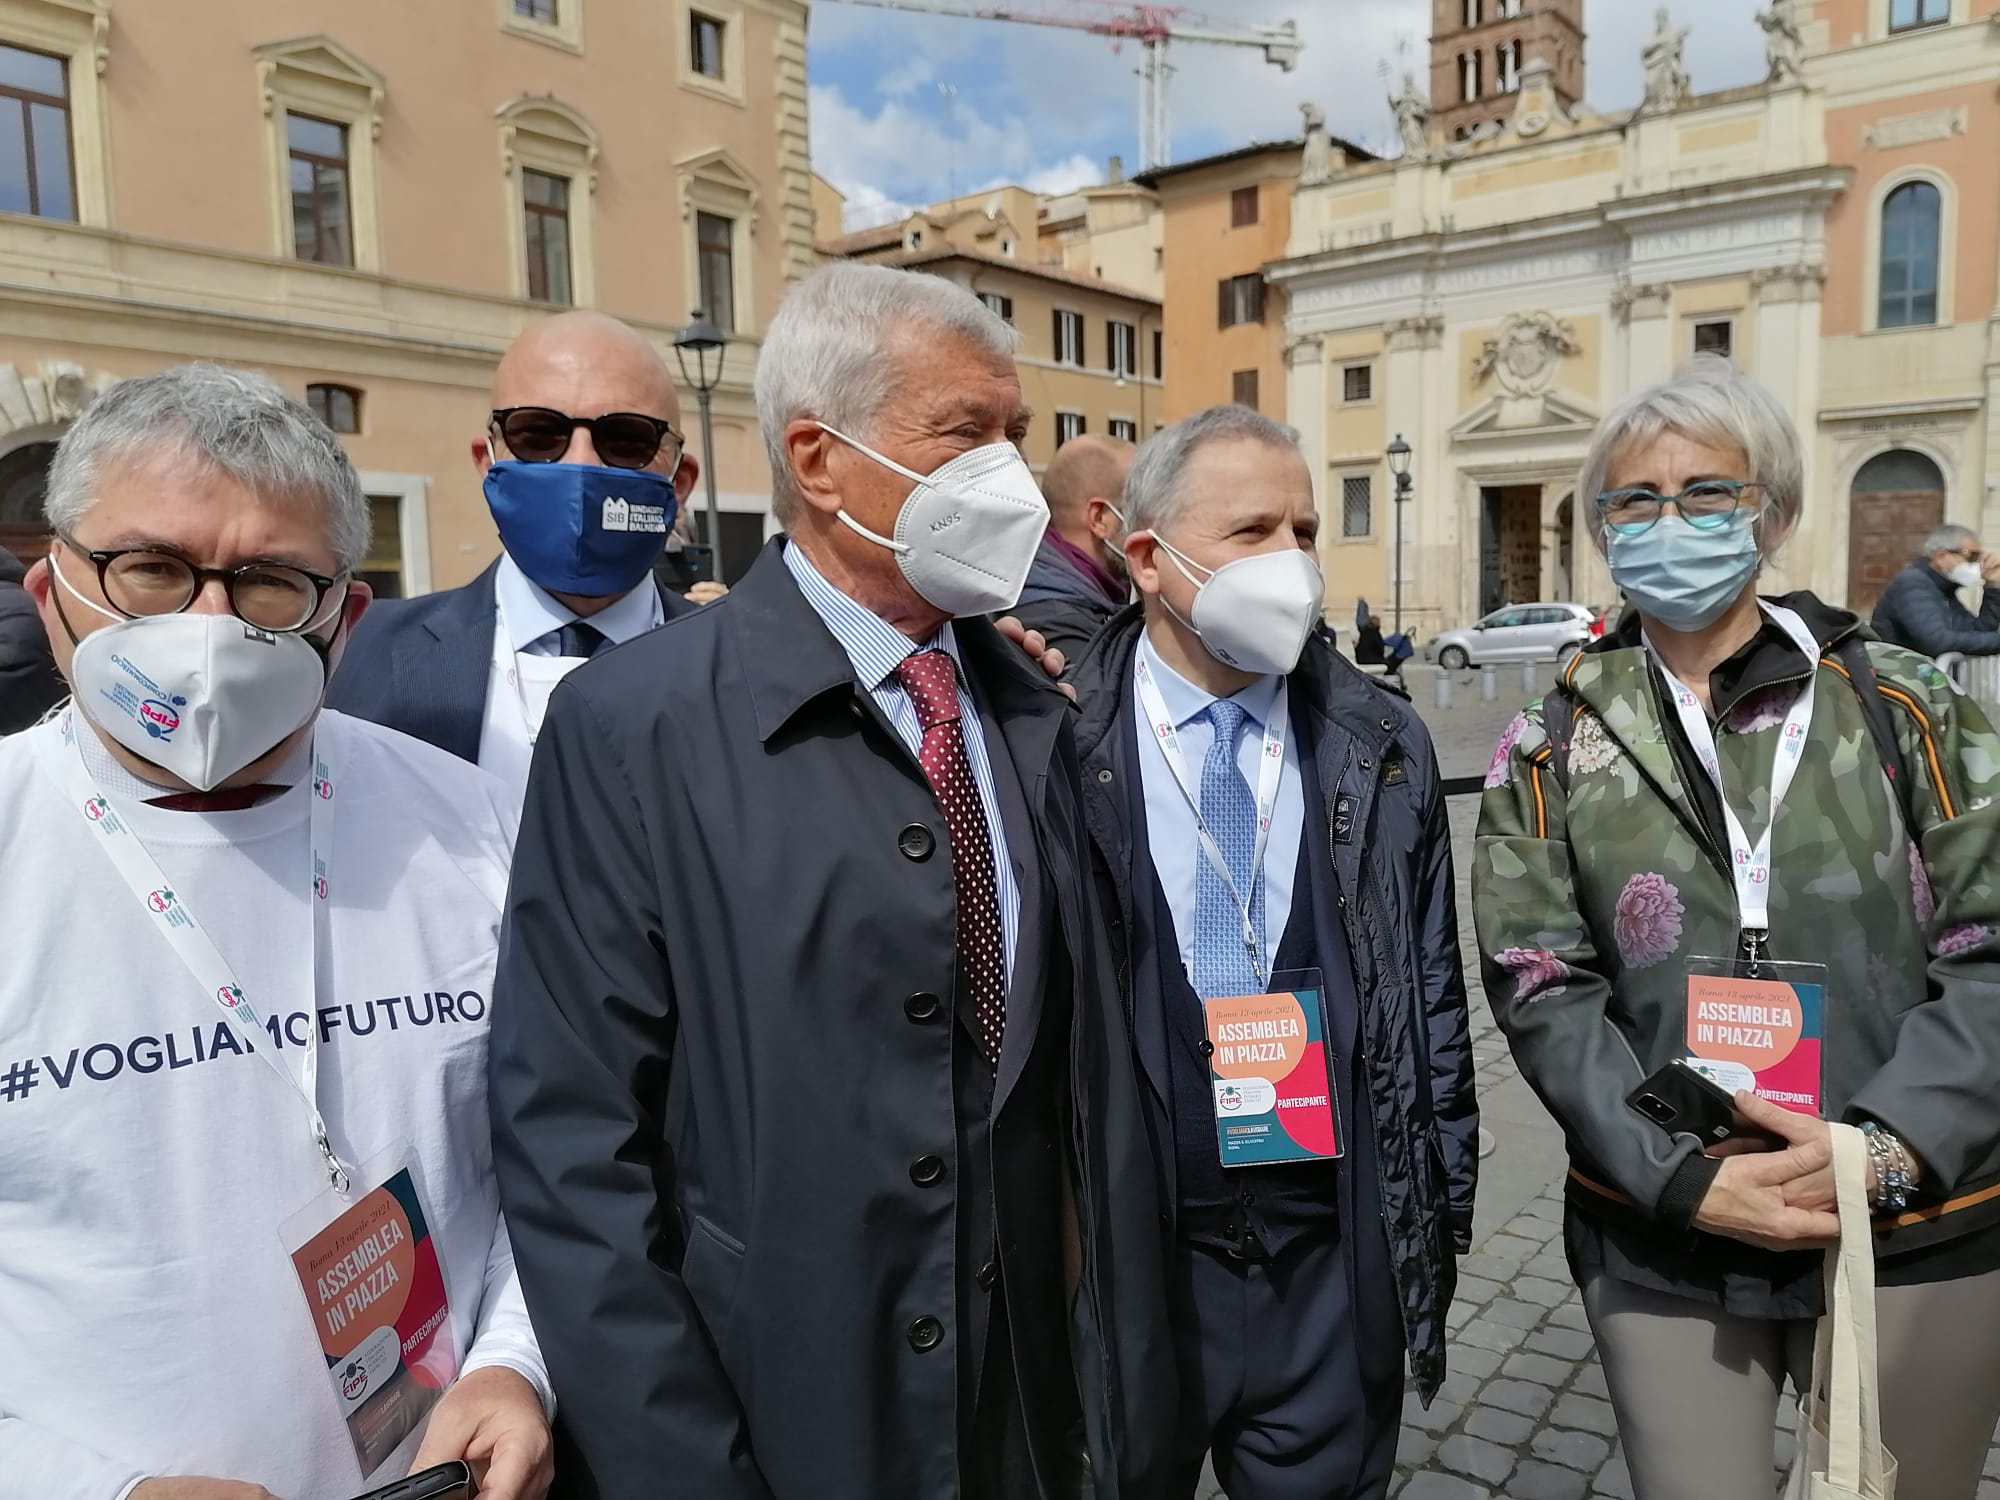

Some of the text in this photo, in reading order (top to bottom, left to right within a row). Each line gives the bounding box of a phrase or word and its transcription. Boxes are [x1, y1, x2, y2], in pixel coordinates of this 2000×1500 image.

[607, 512, 625, 523] SIB
[929, 511, 961, 532] KN95
[140, 701, 180, 729] FIPE
[150, 891, 169, 912] FIPE
[219, 986, 238, 1008] FIPE
[1727, 990, 1738, 998] 13
[1740, 992, 1766, 1001] aprile
[1767, 993, 1792, 1003] 2021
[1215, 1005, 1296, 1020] Roma 13 aprile 2021
[1697, 1001, 1793, 1028] ASSEMBLEA
[1218, 1018, 1300, 1043] ASSEMBLEA
[1697, 1023, 1774, 1049] IN PIAZZA
[1219, 1042, 1287, 1065] IN PIAZZA
[1219, 1096, 1243, 1105] FIPE
[1277, 1095, 1328, 1109] PARTECIPANTE
[1755, 1088, 1814, 1105] PARTECIPANTE
[309, 1200, 392, 1273] Roma 13 aprile 2021
[317, 1218, 405, 1305] ASSEMBLEA
[325, 1260, 400, 1337] IN PIAZZA
[402, 1304, 447, 1356] PARTECIPANTE
[342, 1371, 369, 1398] FIPE
